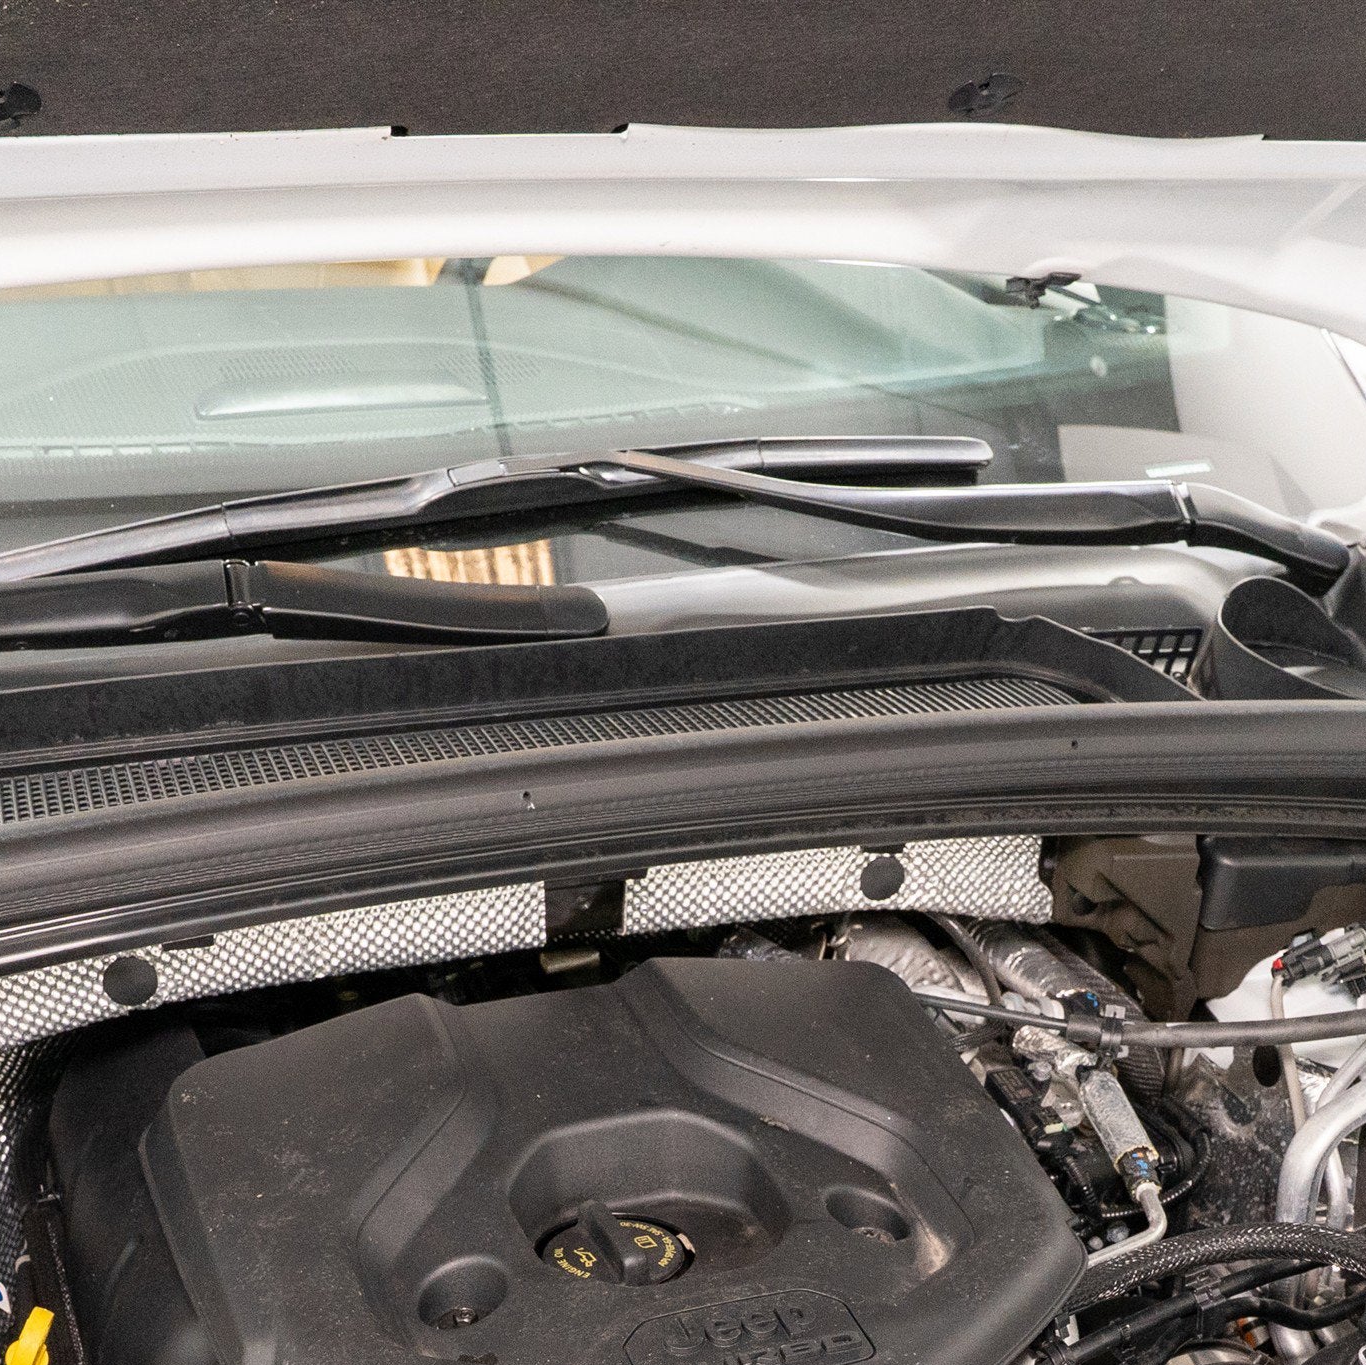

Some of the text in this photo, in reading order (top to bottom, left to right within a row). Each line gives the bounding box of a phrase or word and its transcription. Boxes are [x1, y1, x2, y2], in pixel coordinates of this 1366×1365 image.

[553, 1247, 591, 1279] ENGINE OIL
[664, 1304, 817, 1356] Jeep
